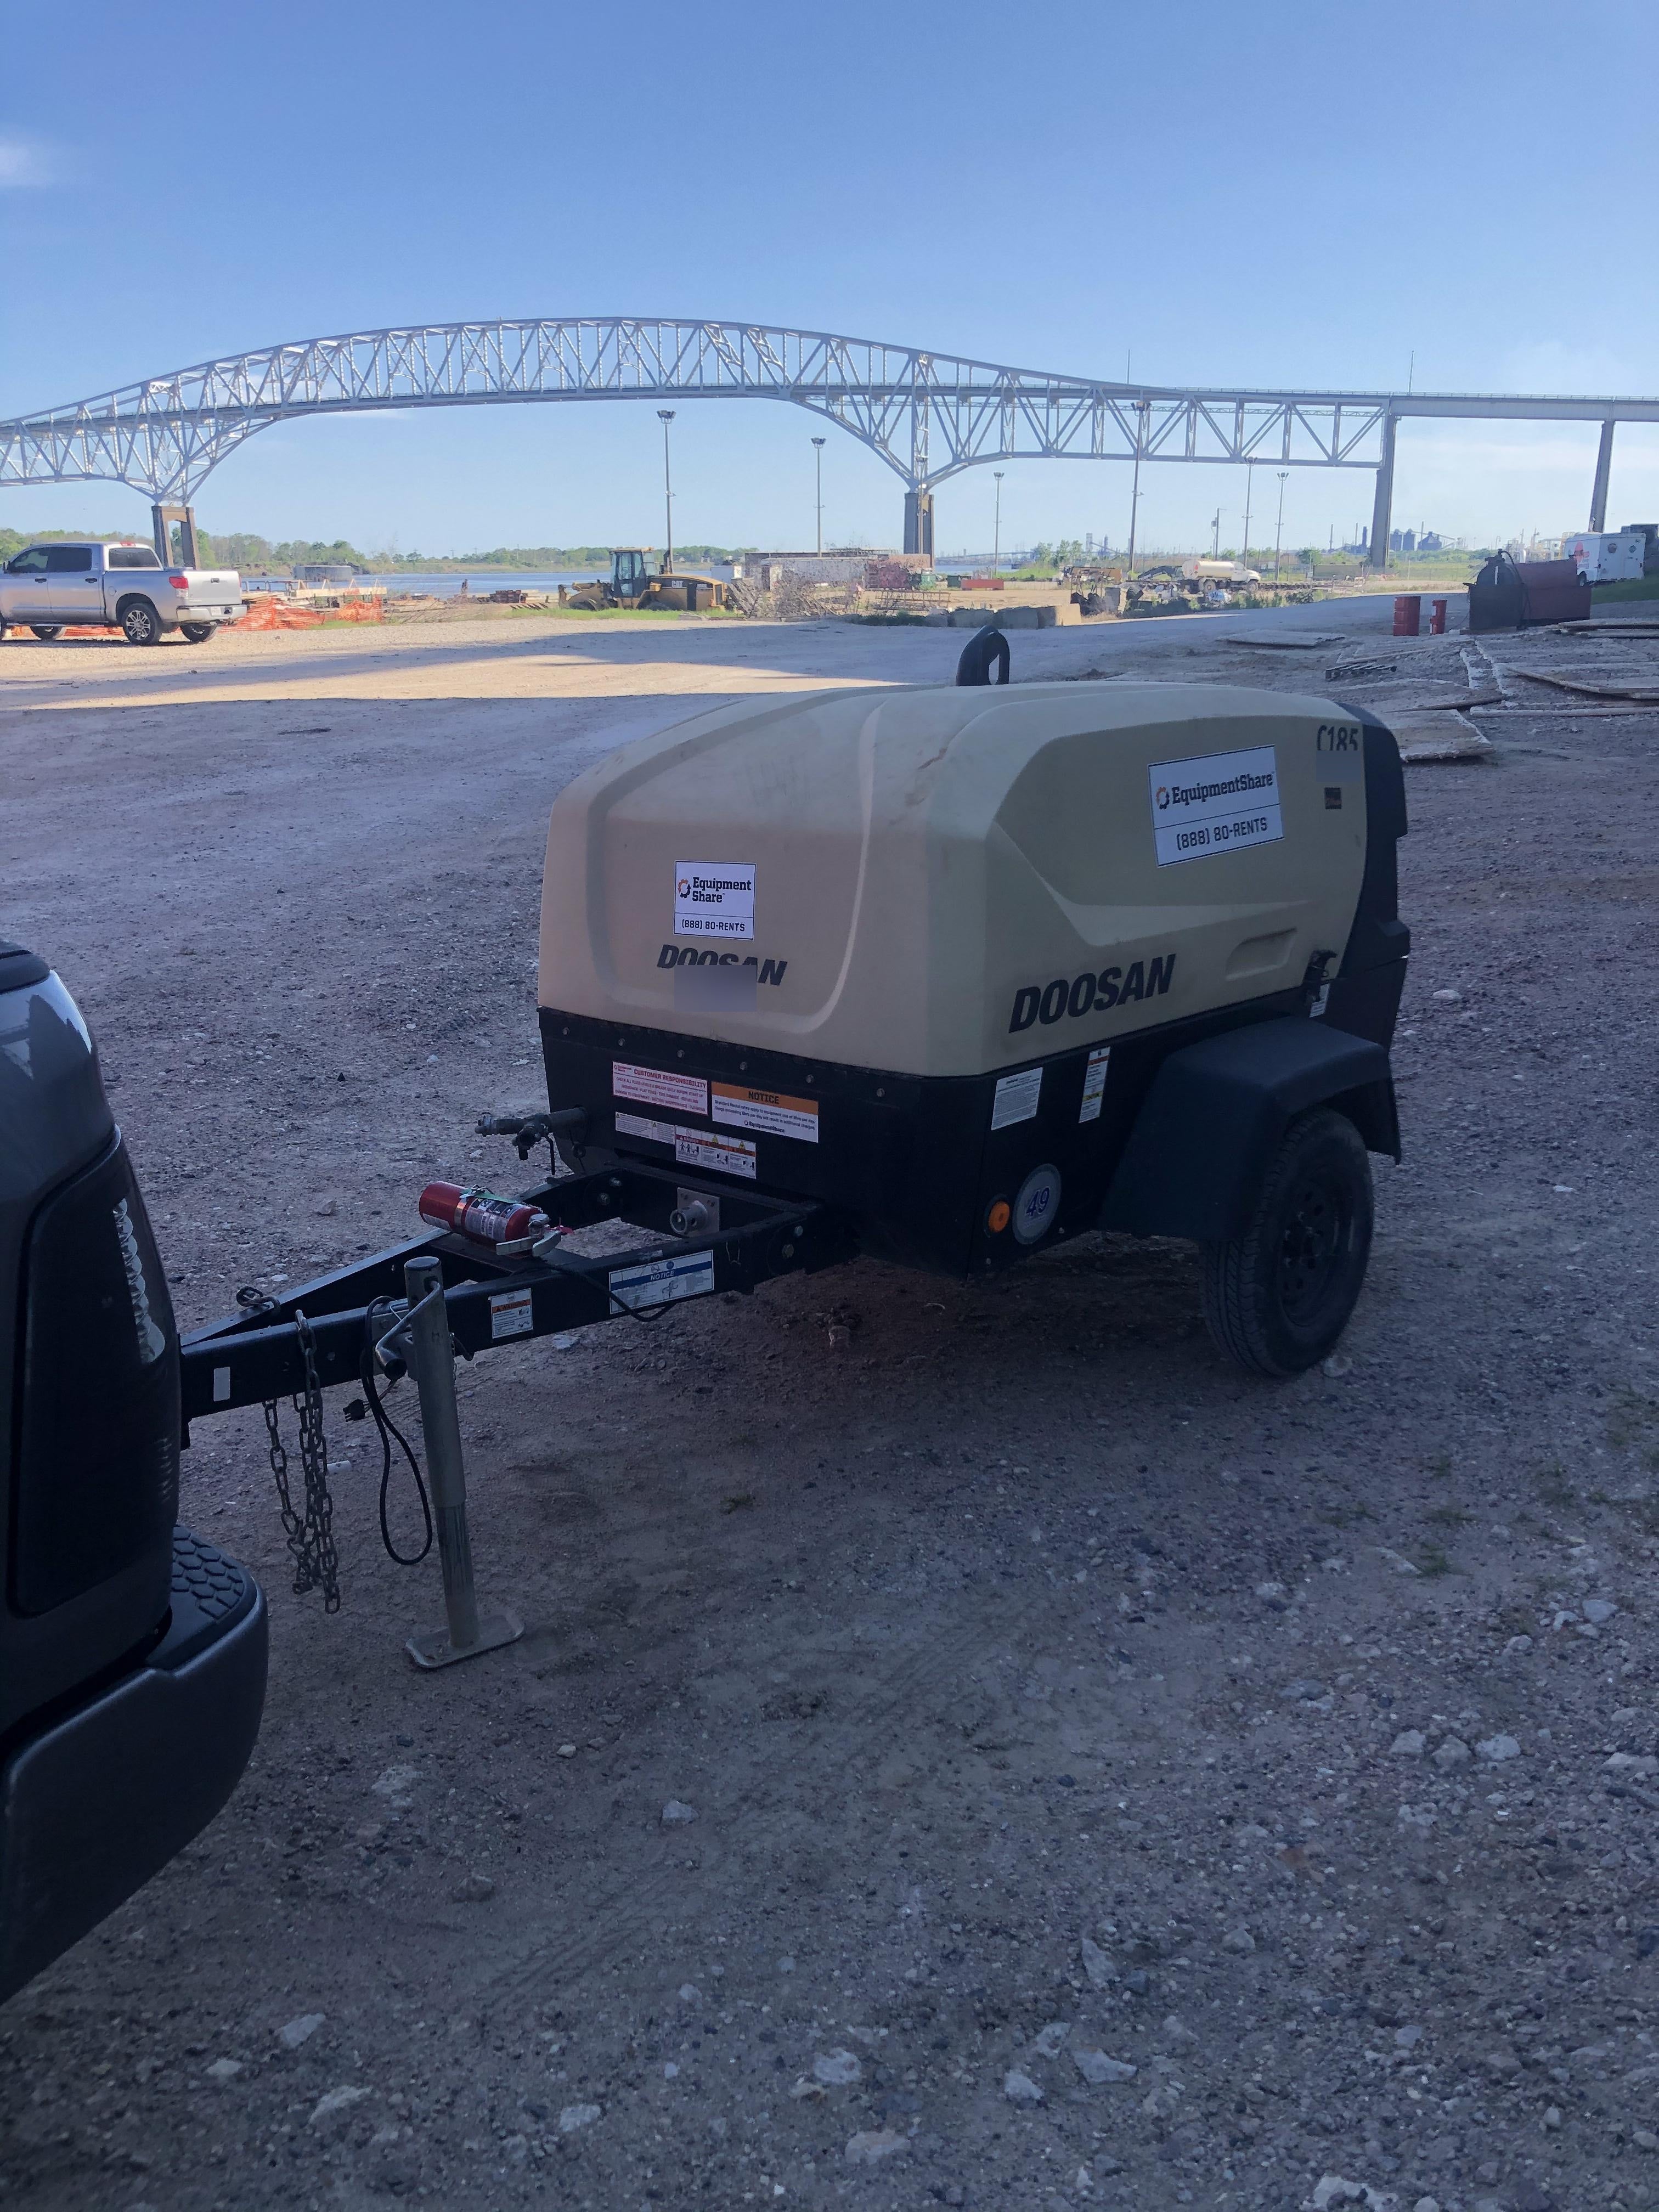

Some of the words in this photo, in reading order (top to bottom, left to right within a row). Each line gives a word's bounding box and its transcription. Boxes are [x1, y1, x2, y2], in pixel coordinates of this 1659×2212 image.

[671, 580, 683, 588] CAT
[1317, 725, 1358, 751] C185
[1171, 774, 1273, 806] EquipmentShare
[1176, 828, 1210, 851] (888)
[1213, 817, 1268, 842] 80-RENTS
[692, 877, 752, 892] Equipment
[692, 890, 723, 903] Share
[682, 919, 703, 929] (888)
[705, 921, 745, 932] 80-RENTS
[1008, 953, 1176, 1033] DOOSAN
[634, 1069, 661, 1080] CUSTOMER
[663, 1075, 706, 1088] RESPONSIBILITY
[748, 1090, 780, 1104] NOTICE
[650, 1270, 675, 1281] NOTICE
